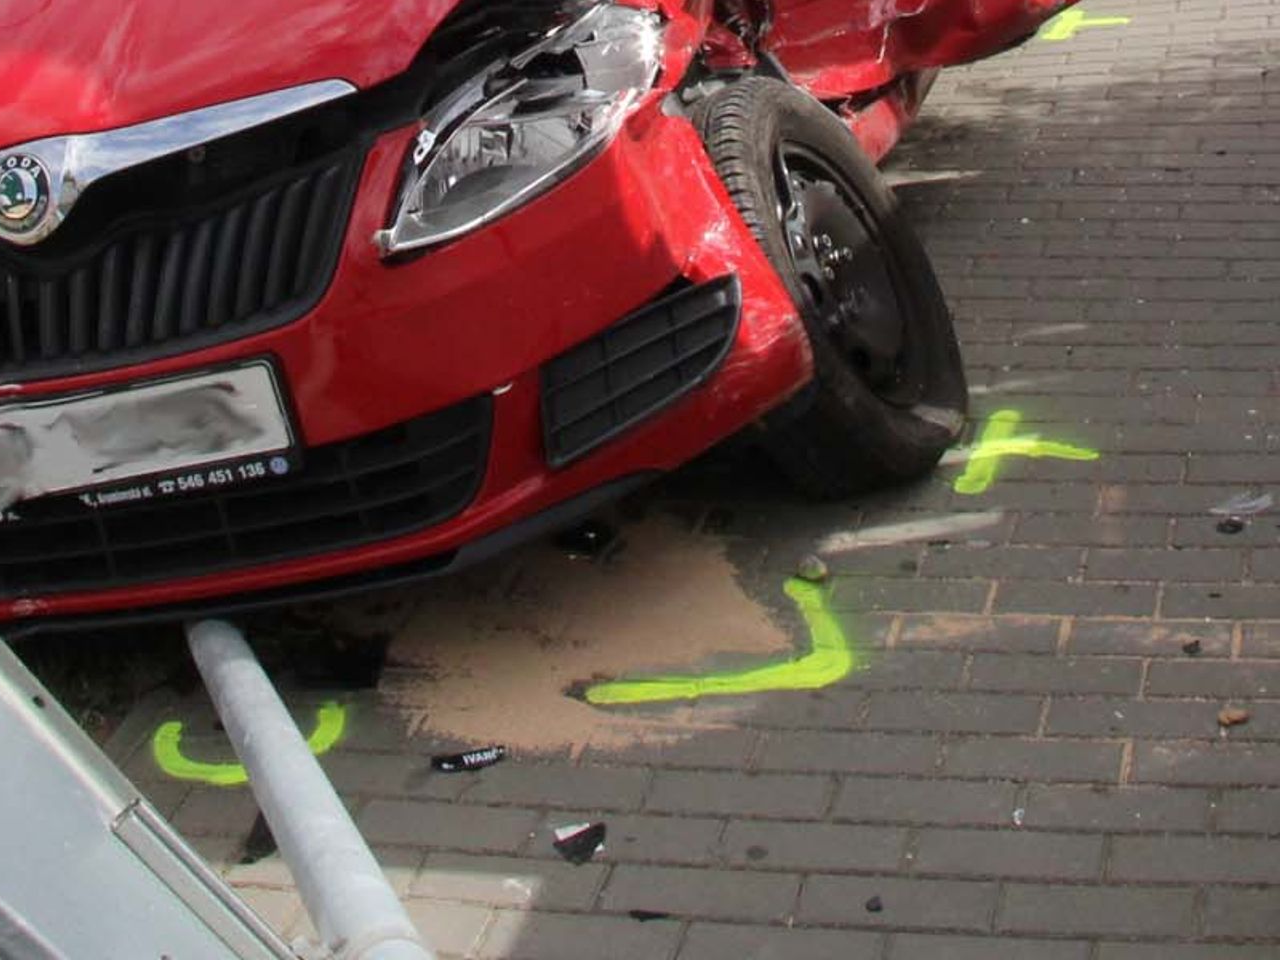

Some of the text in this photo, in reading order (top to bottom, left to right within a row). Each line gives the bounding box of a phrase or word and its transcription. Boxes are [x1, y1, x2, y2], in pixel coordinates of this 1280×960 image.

[177, 473, 205, 491] 546
[207, 468, 233, 485] 451
[238, 461, 266, 480] 136
